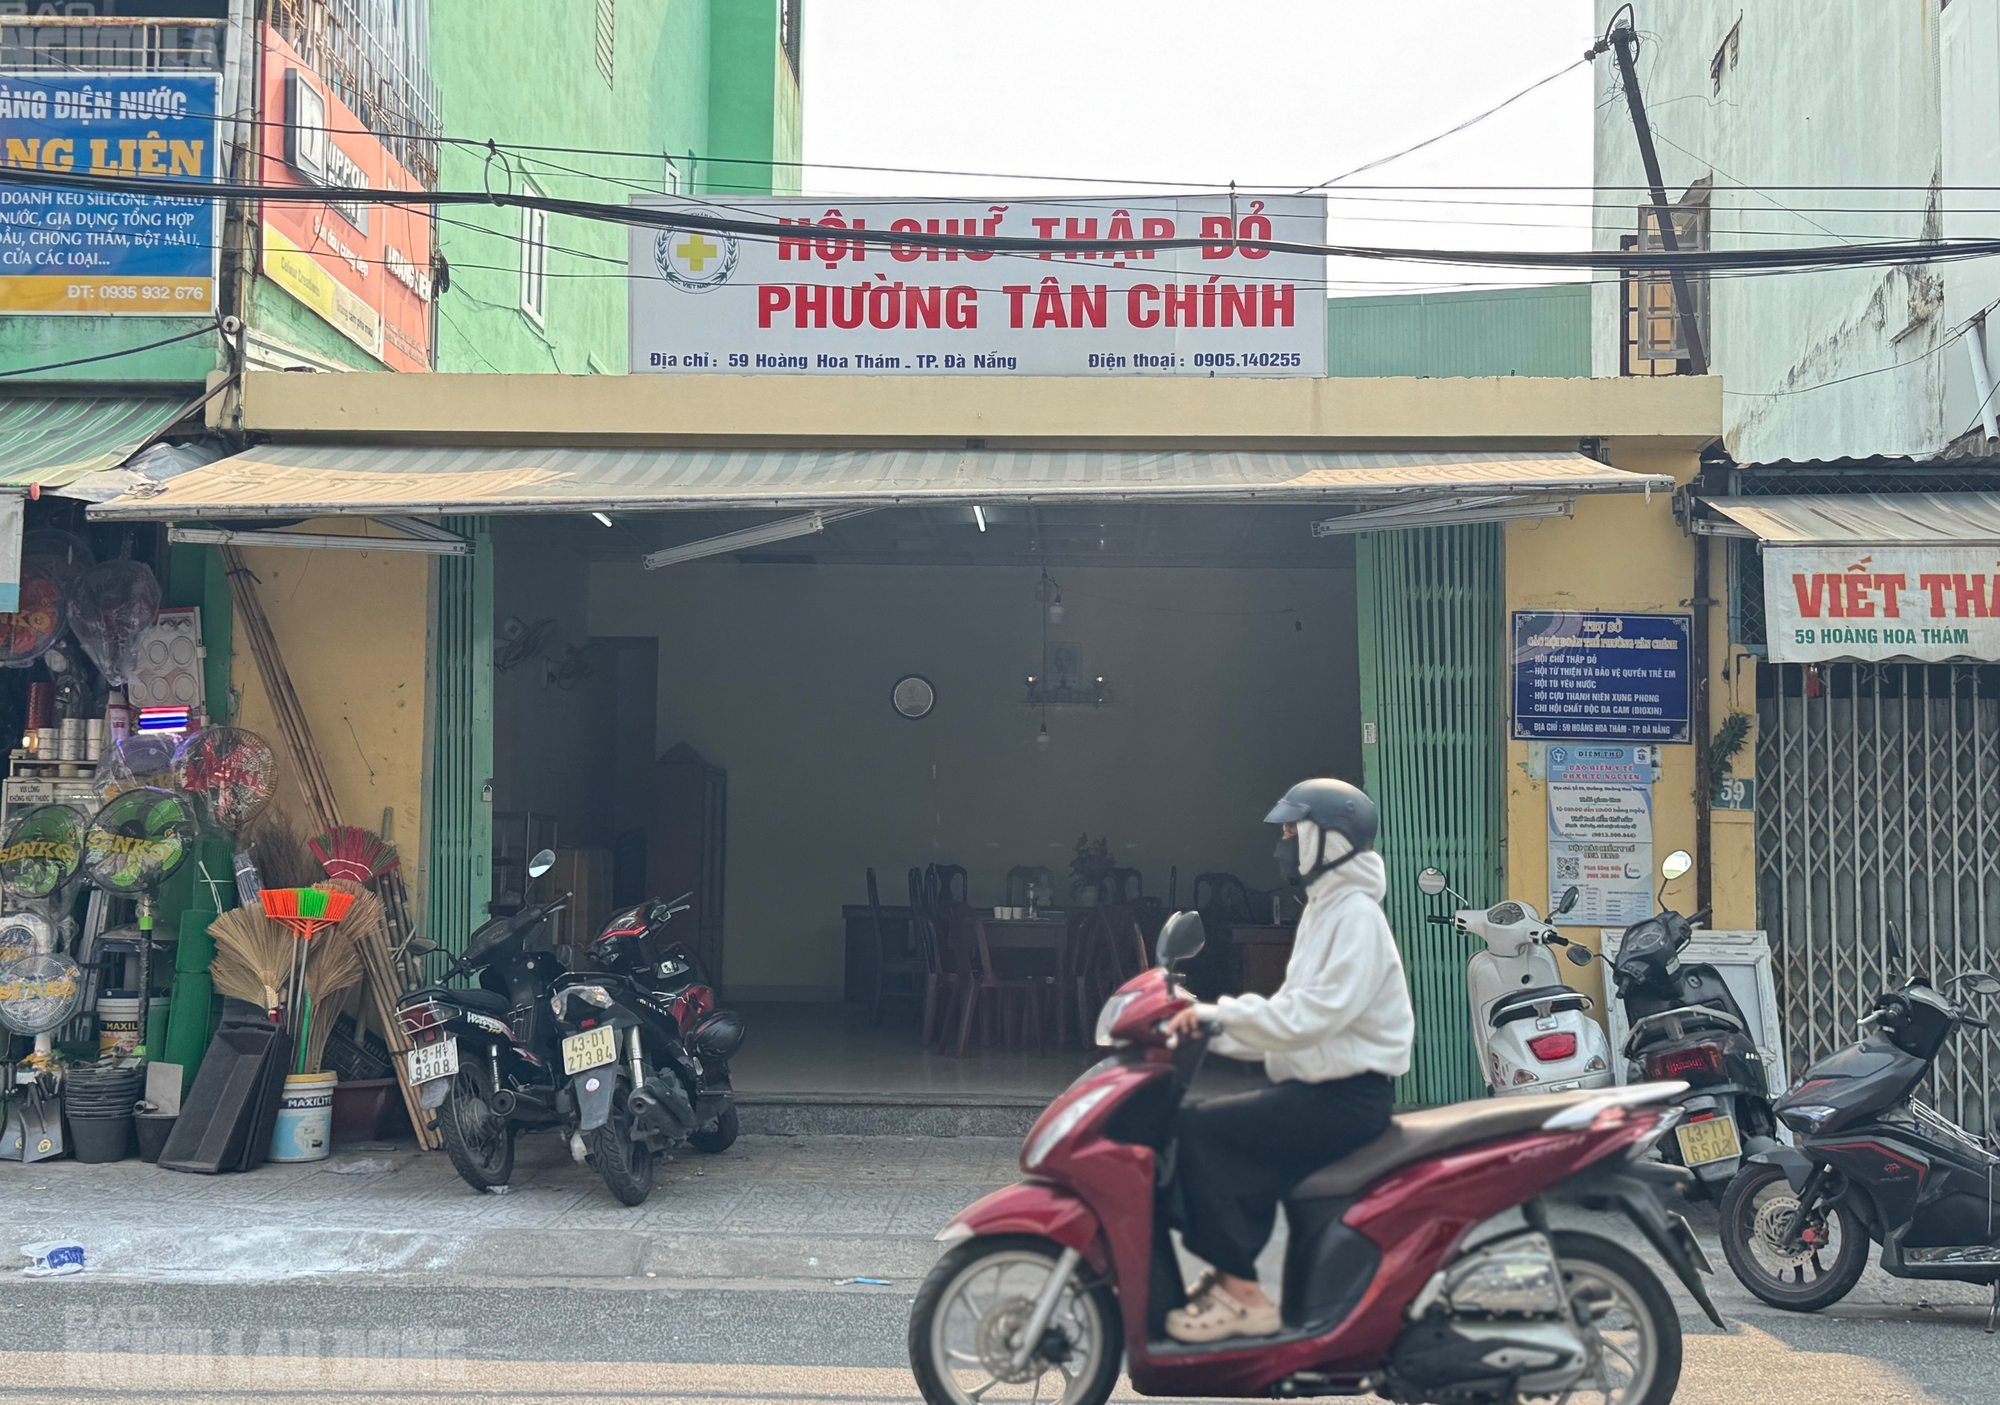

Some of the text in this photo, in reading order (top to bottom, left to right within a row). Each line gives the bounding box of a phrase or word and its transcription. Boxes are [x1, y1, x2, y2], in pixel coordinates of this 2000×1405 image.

[54, 85, 112, 125] ĐIỆN
[119, 86, 187, 120] NƯỚC
[0, 130, 204, 177] NG LIÊN
[1, 192, 52, 205] DOANH
[57, 192, 84, 205] KEO
[46, 213, 72, 225] GIA
[76, 213, 118, 228] DỤNG
[122, 207, 162, 226] TỔNG
[165, 213, 195, 229] HỢP
[29, 226, 82, 245] CHỐNG
[86, 227, 131, 247] THẤM,
[134, 231, 161, 248] BỘT
[778, 208, 866, 270] HỘI
[1031, 208, 1176, 269] THẬP
[1199, 200, 1273, 260] ĐỎ
[3, 248, 110, 268] CỬA CÁC LOẠI...
[68, 285, 204, 299] ĐT: 0935 932 676
[757, 273, 1296, 330] PHƯỜNG TÂN CHÍNH
[649, 352, 678, 371] Địa
[728, 354, 749, 368] 59
[756, 352, 808, 369] Hoàng
[816, 354, 849, 368] Hoa
[854, 353, 900, 368] Thám
[916, 354, 939, 368] TP.
[943, 353, 966, 368] Đà
[974, 351, 1017, 370] Nẵng
[1088, 352, 1126, 369] Điện
[1133, 352, 1176, 369] thoại
[1194, 352, 1301, 368] 0905.140255
[1792, 556, 1906, 618] VIẾT
[1794, 626, 1969, 644] 59 HOÀNG HOA THÁM
[1534, 653, 1548, 664] HỘI
[1534, 666, 1548, 677] HỘI
[1663, 670, 1676, 678] EM
[1534, 678, 1548, 689] HỘI
[1534, 690, 1548, 701] HỘI
[1566, 692, 1591, 701] THANH
[1611, 693, 1633, 702] XUNG
[1634, 694, 1660, 703] PHONG
[1534, 704, 1548, 712] CHI
[1549, 703, 1562, 714] HỘI
[1612, 706, 1630, 714] CAM
[1720, 779, 1746, 802] 59
[0, 841, 74, 864] SENKO
[86, 830, 171, 861] SENKO
[571, 1030, 605, 1053] 43-D1
[568, 1045, 613, 1071] 273.84
[416, 1059, 450, 1081] 9308
